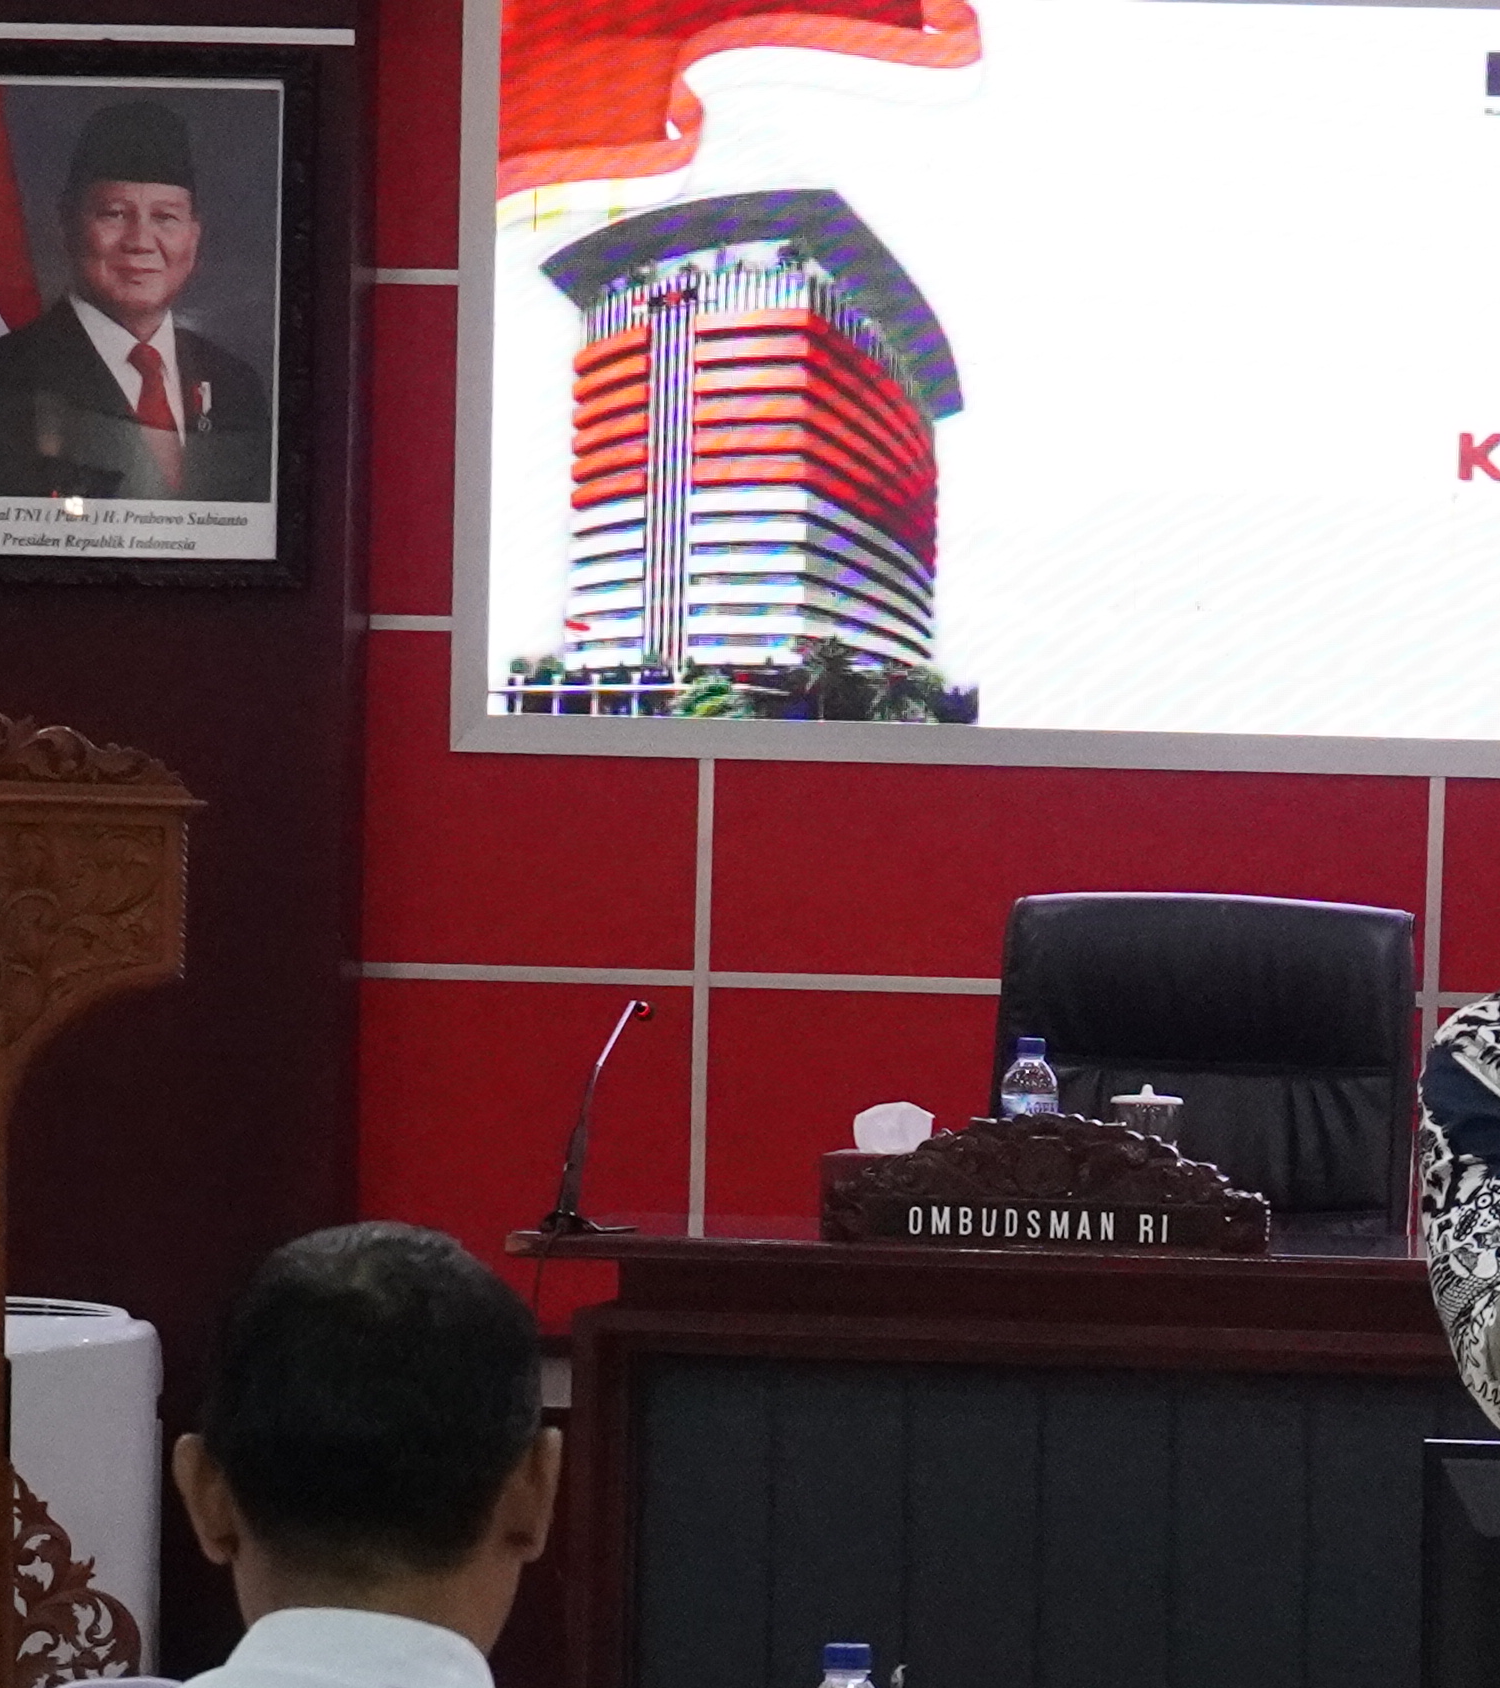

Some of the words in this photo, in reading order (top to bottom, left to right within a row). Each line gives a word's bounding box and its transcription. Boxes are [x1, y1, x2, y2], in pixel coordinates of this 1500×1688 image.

[15, 508, 43, 522] TNI
[187, 512, 248, 526] Subianto
[3, 532, 61, 548] Presiden
[65, 534, 125, 551] Republik
[128, 536, 197, 551] Indonesia
[907, 1205, 1115, 1241] OMBUDSMAN
[1138, 1213, 1169, 1243] RI
